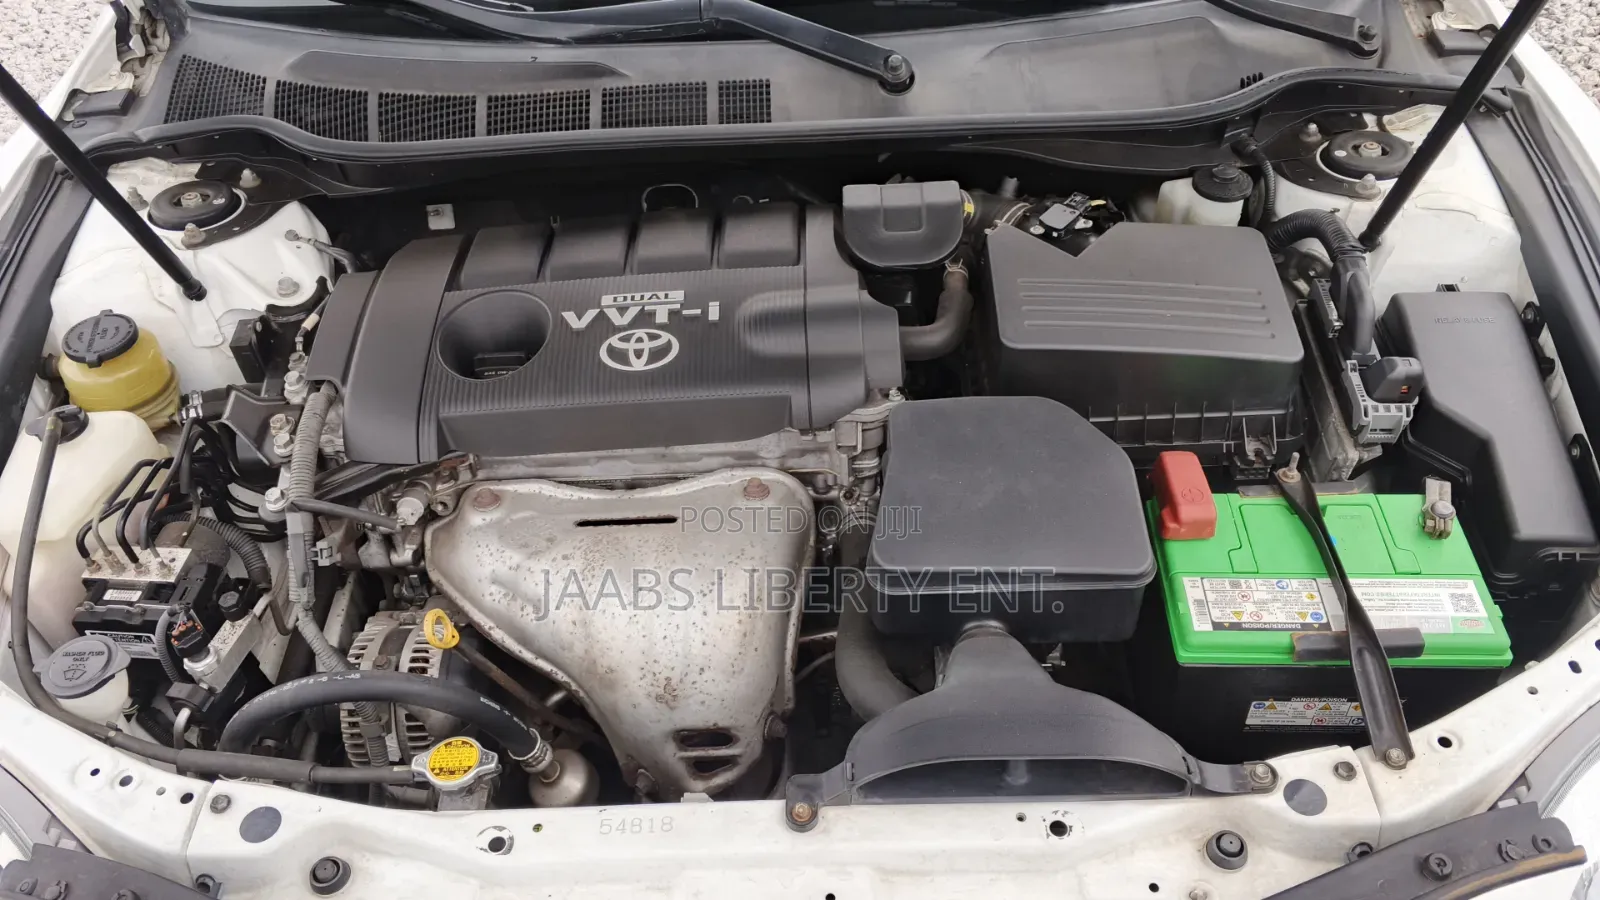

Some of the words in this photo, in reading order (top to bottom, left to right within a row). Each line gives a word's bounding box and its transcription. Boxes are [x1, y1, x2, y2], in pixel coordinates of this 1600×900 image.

[612, 292, 677, 303] DUAL
[561, 301, 720, 331] VVT-i
[599, 816, 674, 835] 54818
